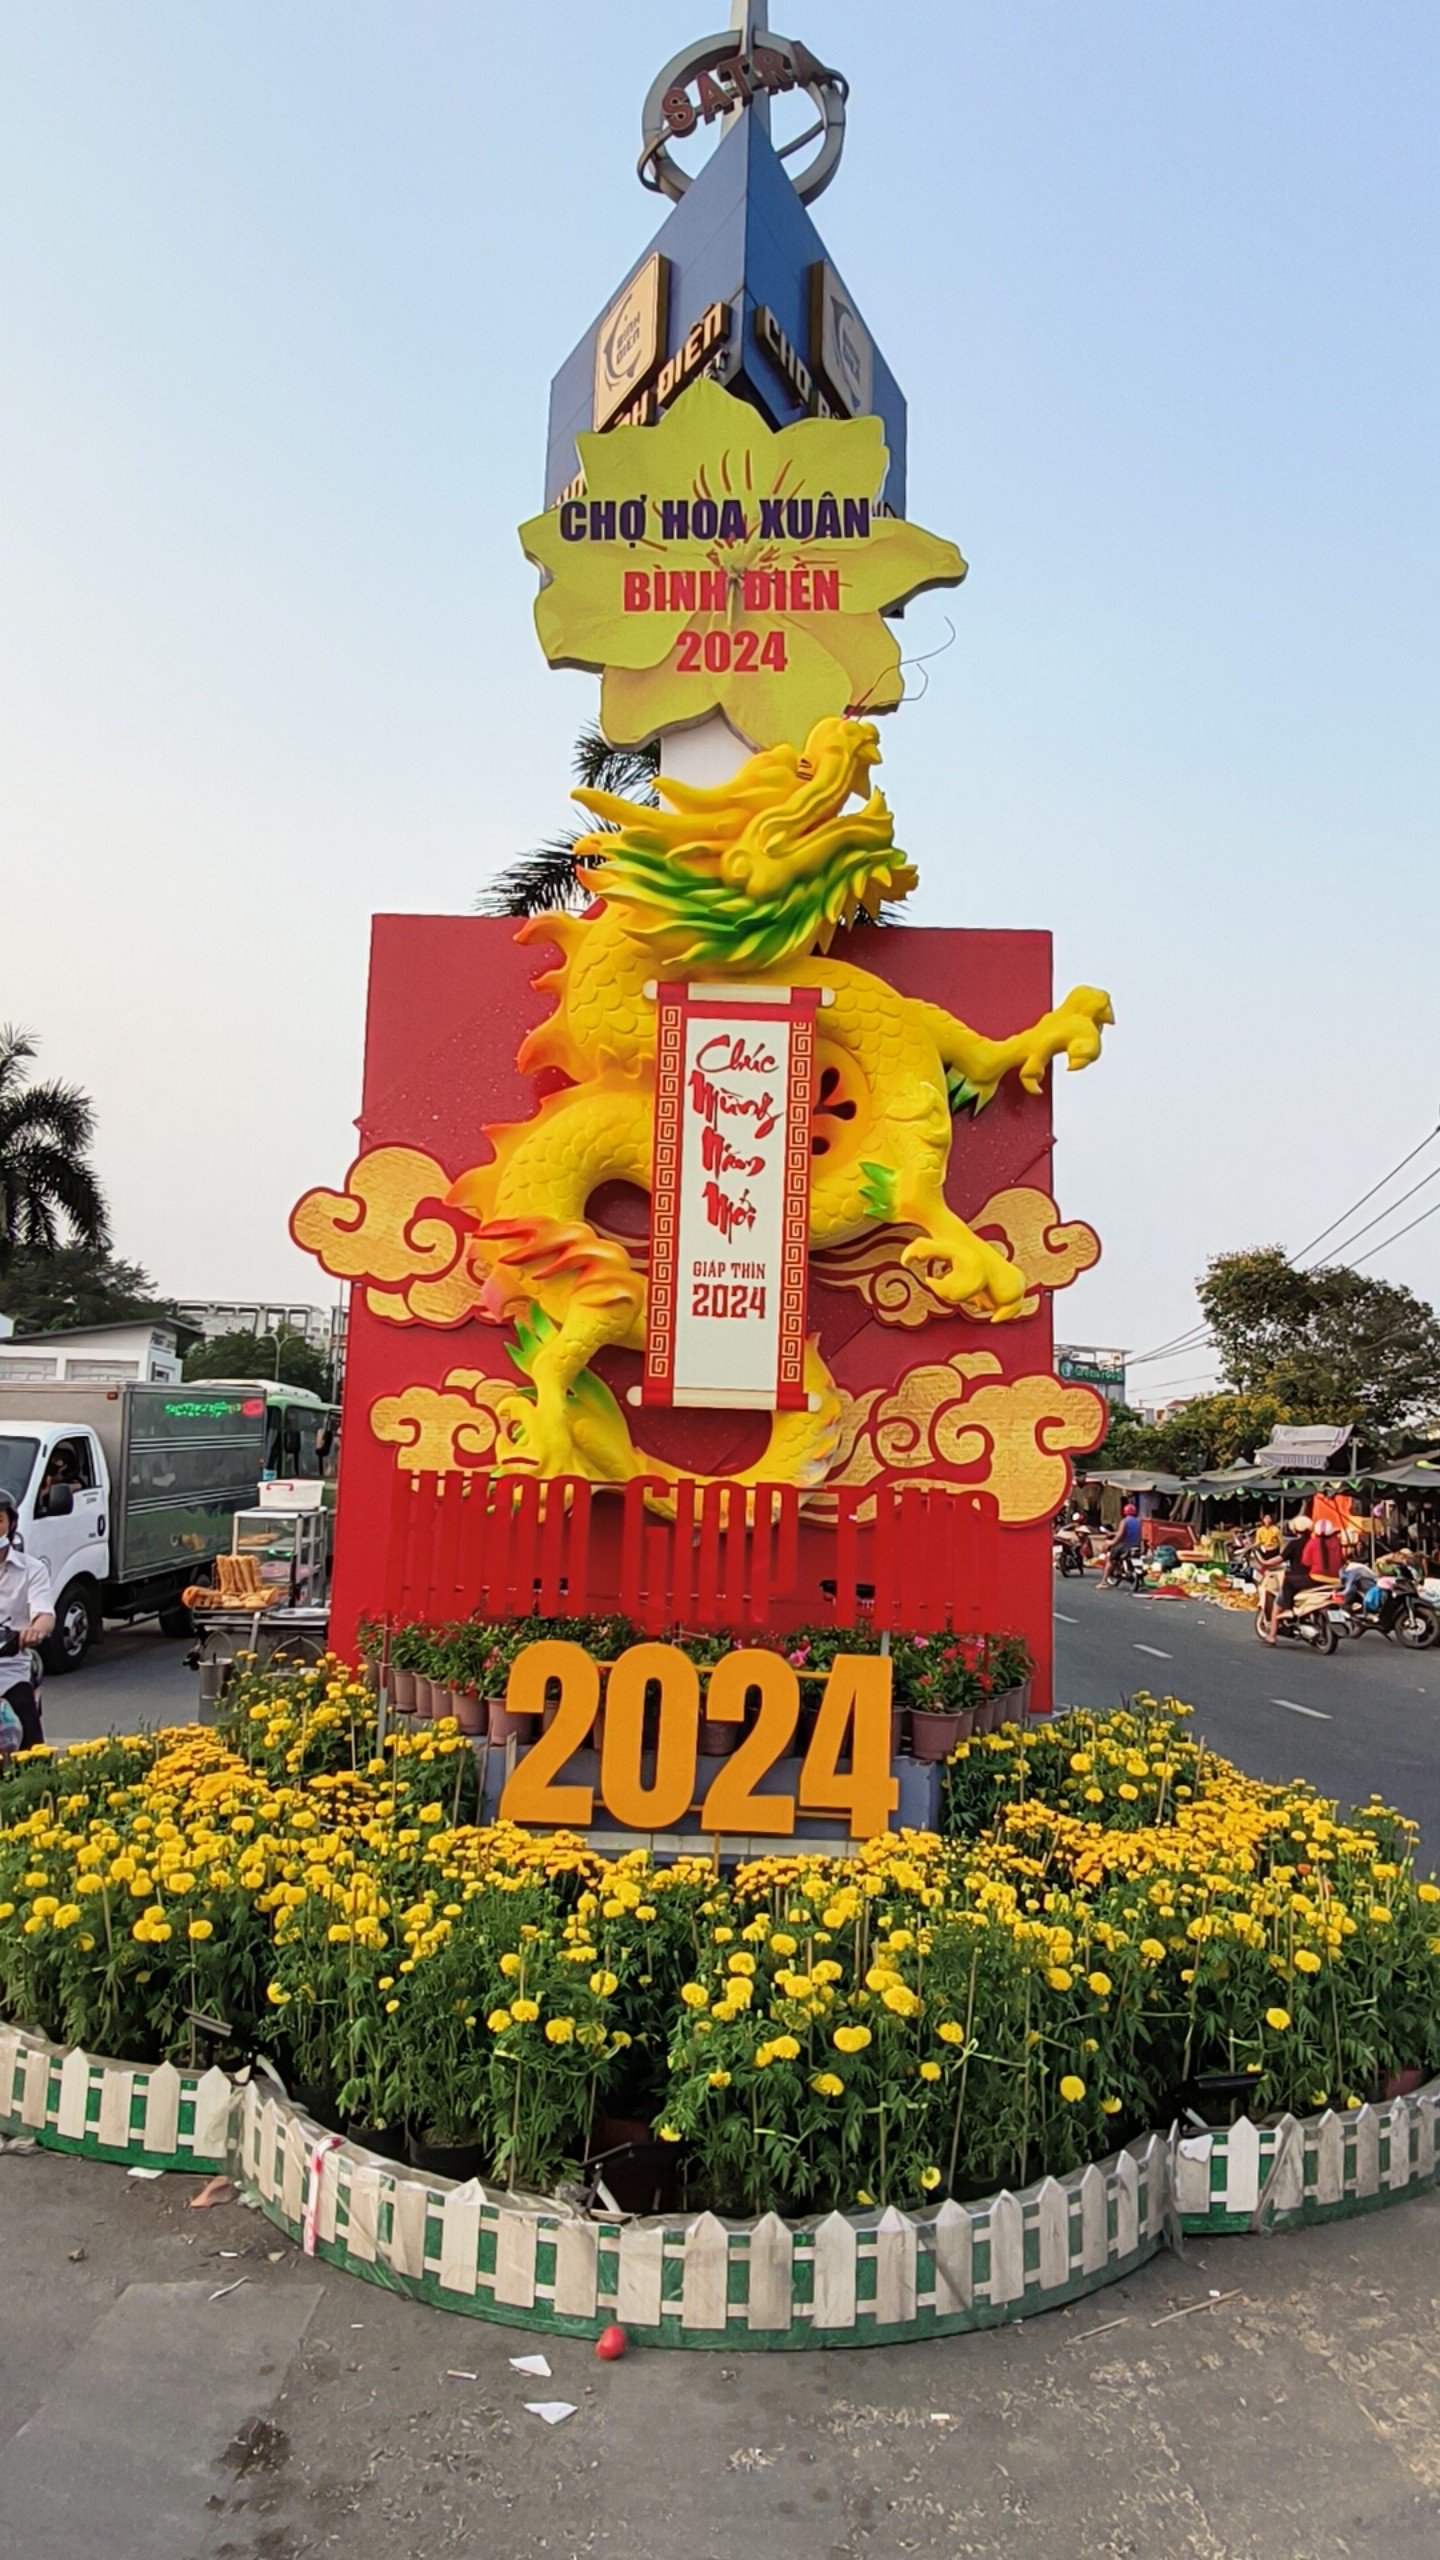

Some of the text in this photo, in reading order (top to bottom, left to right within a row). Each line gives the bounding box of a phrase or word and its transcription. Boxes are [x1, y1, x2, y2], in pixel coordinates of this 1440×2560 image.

[559, 491, 871, 548] CHỢ HOA XUÂN
[623, 555, 840, 612] BÌNH ĐIỀN
[675, 631, 789, 673] 2024
[695, 1034, 780, 1074] Chúc
[687, 1069, 785, 1139] Mừng
[701, 1126, 766, 1180] Năm
[701, 1181, 757, 1244] Mới
[693, 1259, 766, 1279] GIÁP THÌN
[692, 1283, 767, 1319] 2024
[498, 1640, 899, 1837] 2024
